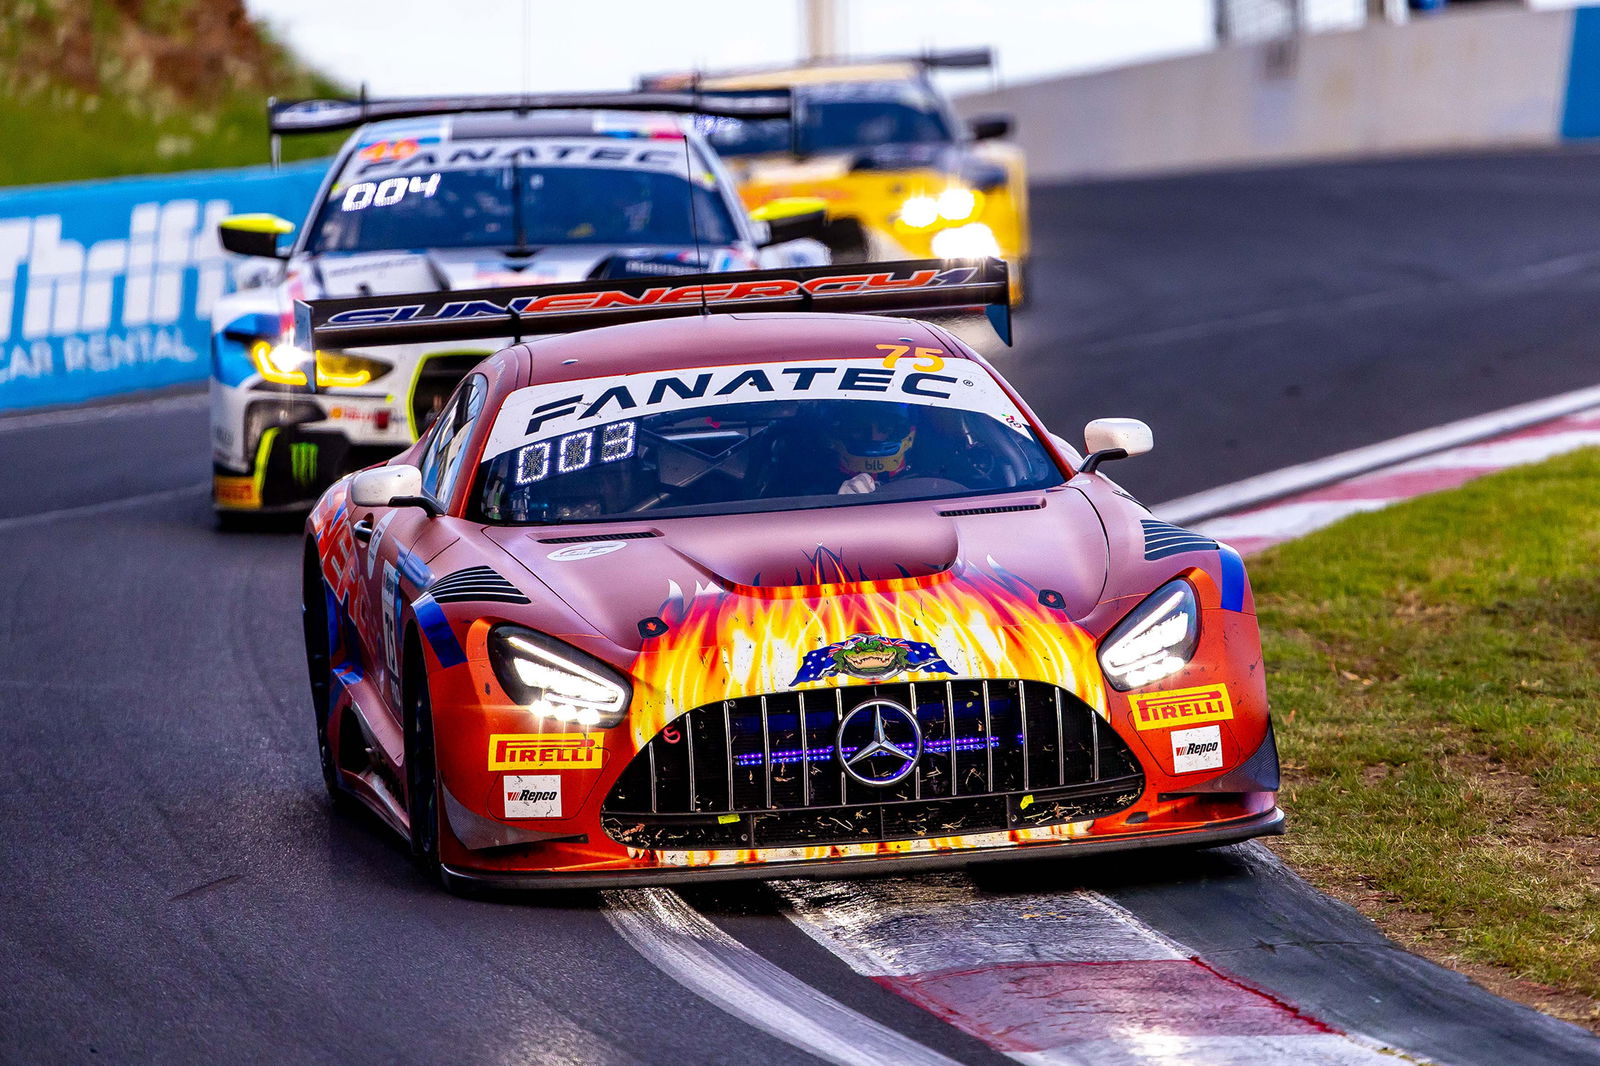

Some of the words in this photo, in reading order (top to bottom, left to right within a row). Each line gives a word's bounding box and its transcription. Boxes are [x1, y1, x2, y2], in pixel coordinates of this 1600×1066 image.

[359, 136, 422, 163] 46
[341, 172, 441, 212] 004
[328, 267, 978, 323] SUNENERGY1
[63, 327, 198, 373] RENTAL
[875, 344, 945, 372] 75
[524, 367, 958, 436] FANATEC
[514, 420, 637, 485] 003
[1137, 690, 1225, 721] PIRELLI
[495, 738, 596, 763] PIRELLI
[1186, 741, 1219, 756] Repco
[519, 789, 558, 803] Repco
